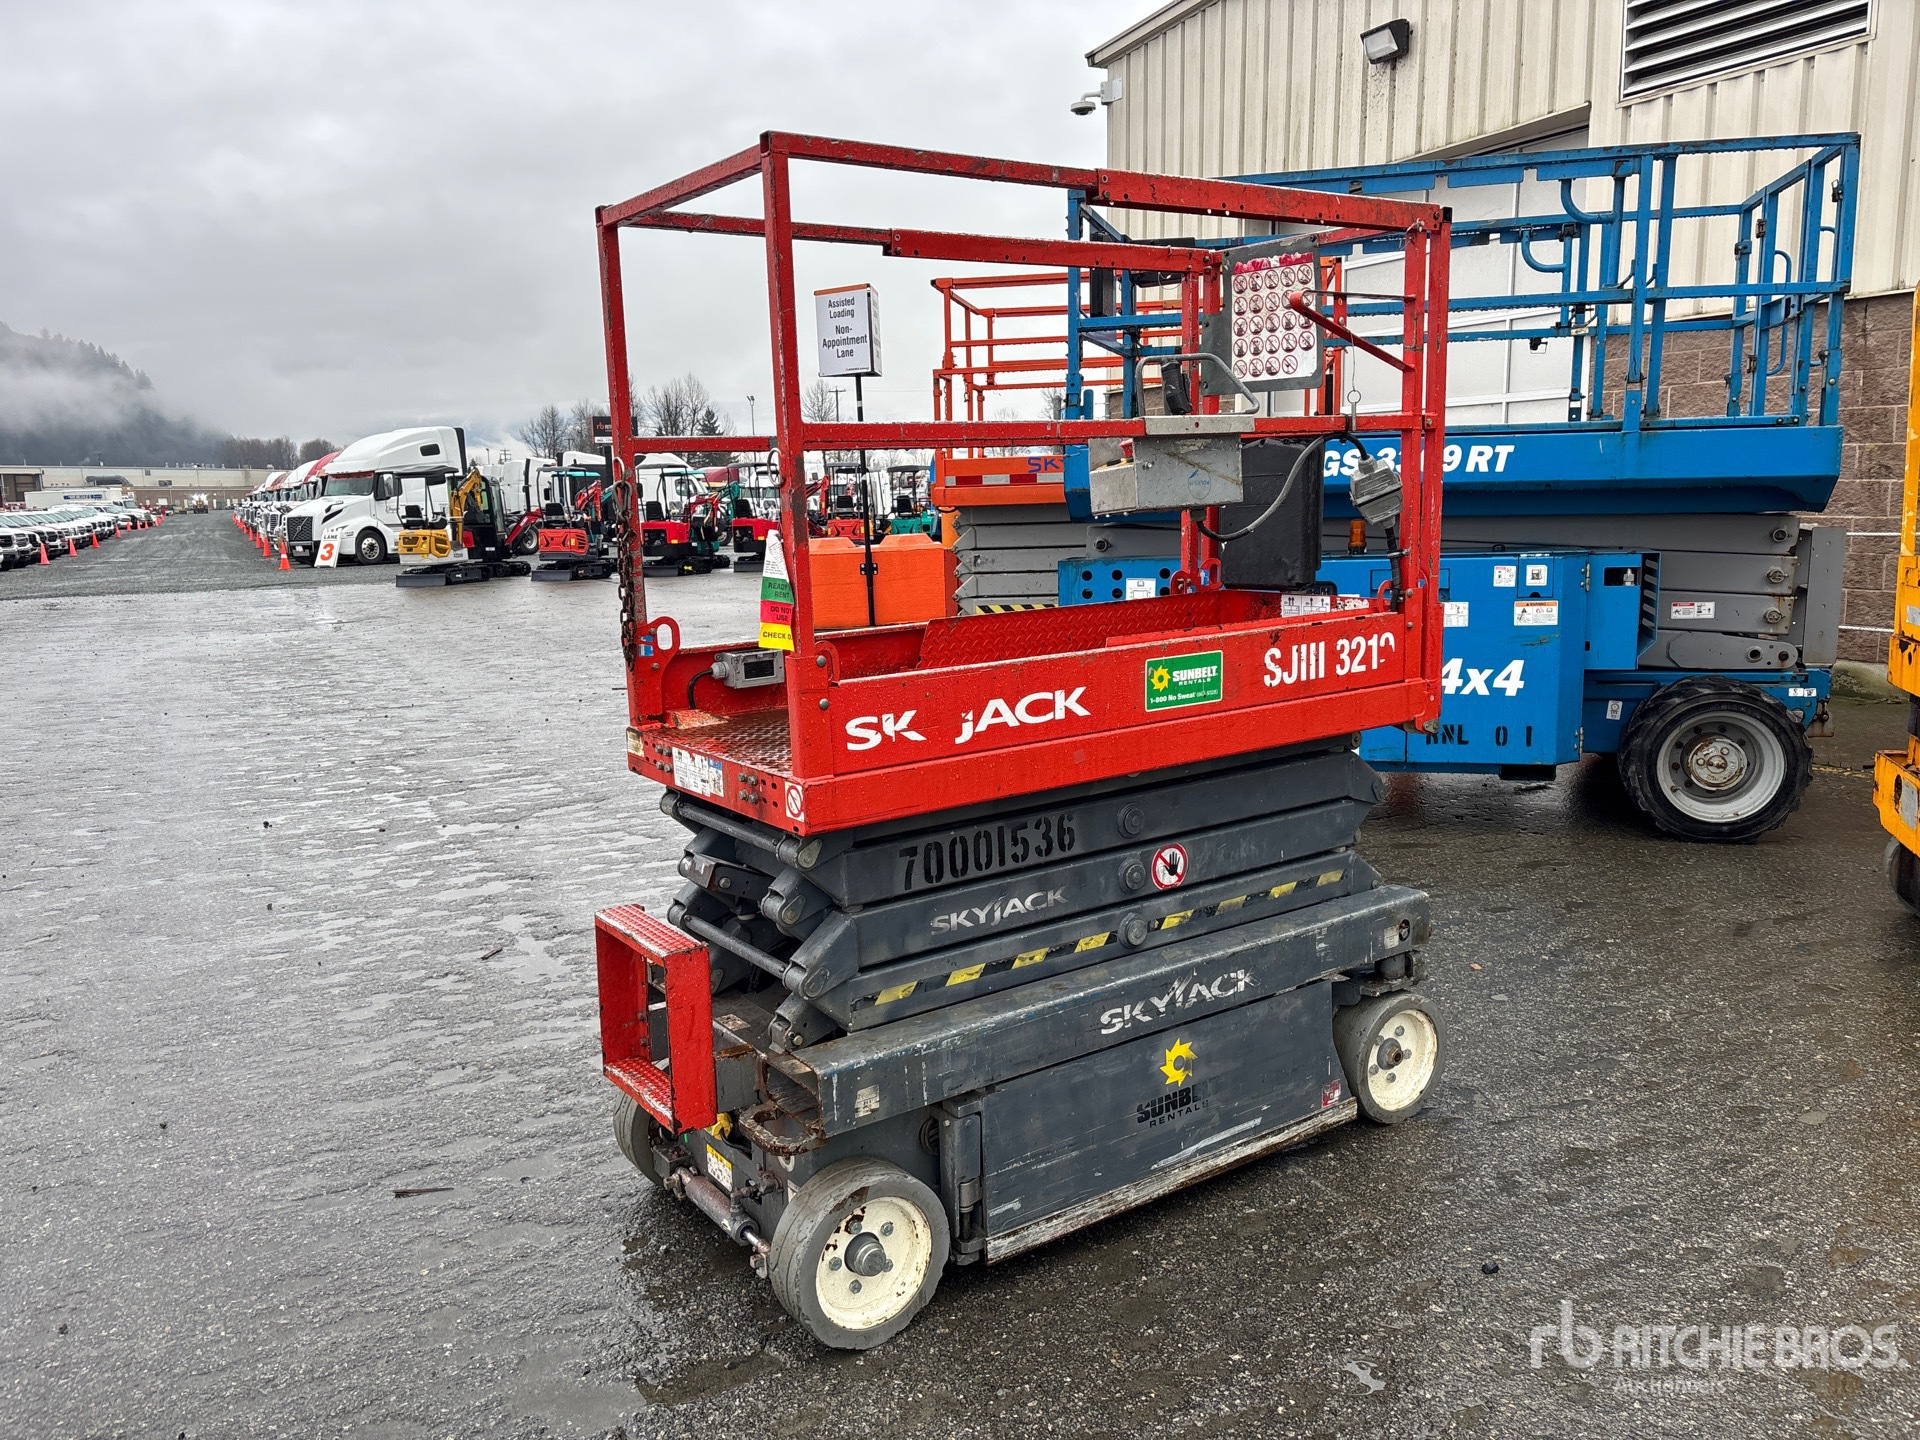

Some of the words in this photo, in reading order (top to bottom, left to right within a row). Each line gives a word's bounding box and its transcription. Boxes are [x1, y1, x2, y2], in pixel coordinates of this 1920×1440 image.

[828, 297, 854, 308] Assisted
[830, 309, 854, 318] Loading
[836, 325, 852, 334] Non-
[822, 334, 867, 349] Appointment
[836, 349, 854, 358] Lane
[1465, 445, 1515, 473] RT
[1027, 456, 1064, 474] SK
[320, 543, 335, 562] 3
[768, 582, 787, 590] READY
[774, 591, 790, 599] RENT
[776, 614, 788, 622] USE
[762, 630, 787, 640] CHECK
[1172, 666, 1218, 682] SUNBELT
[1441, 657, 1525, 697] 4x4
[1178, 678, 1211, 686] RENTALS
[1150, 696, 1168, 704] 1-800
[899, 813, 1076, 891] 70001536
[930, 885, 1070, 936] SKYJACK
